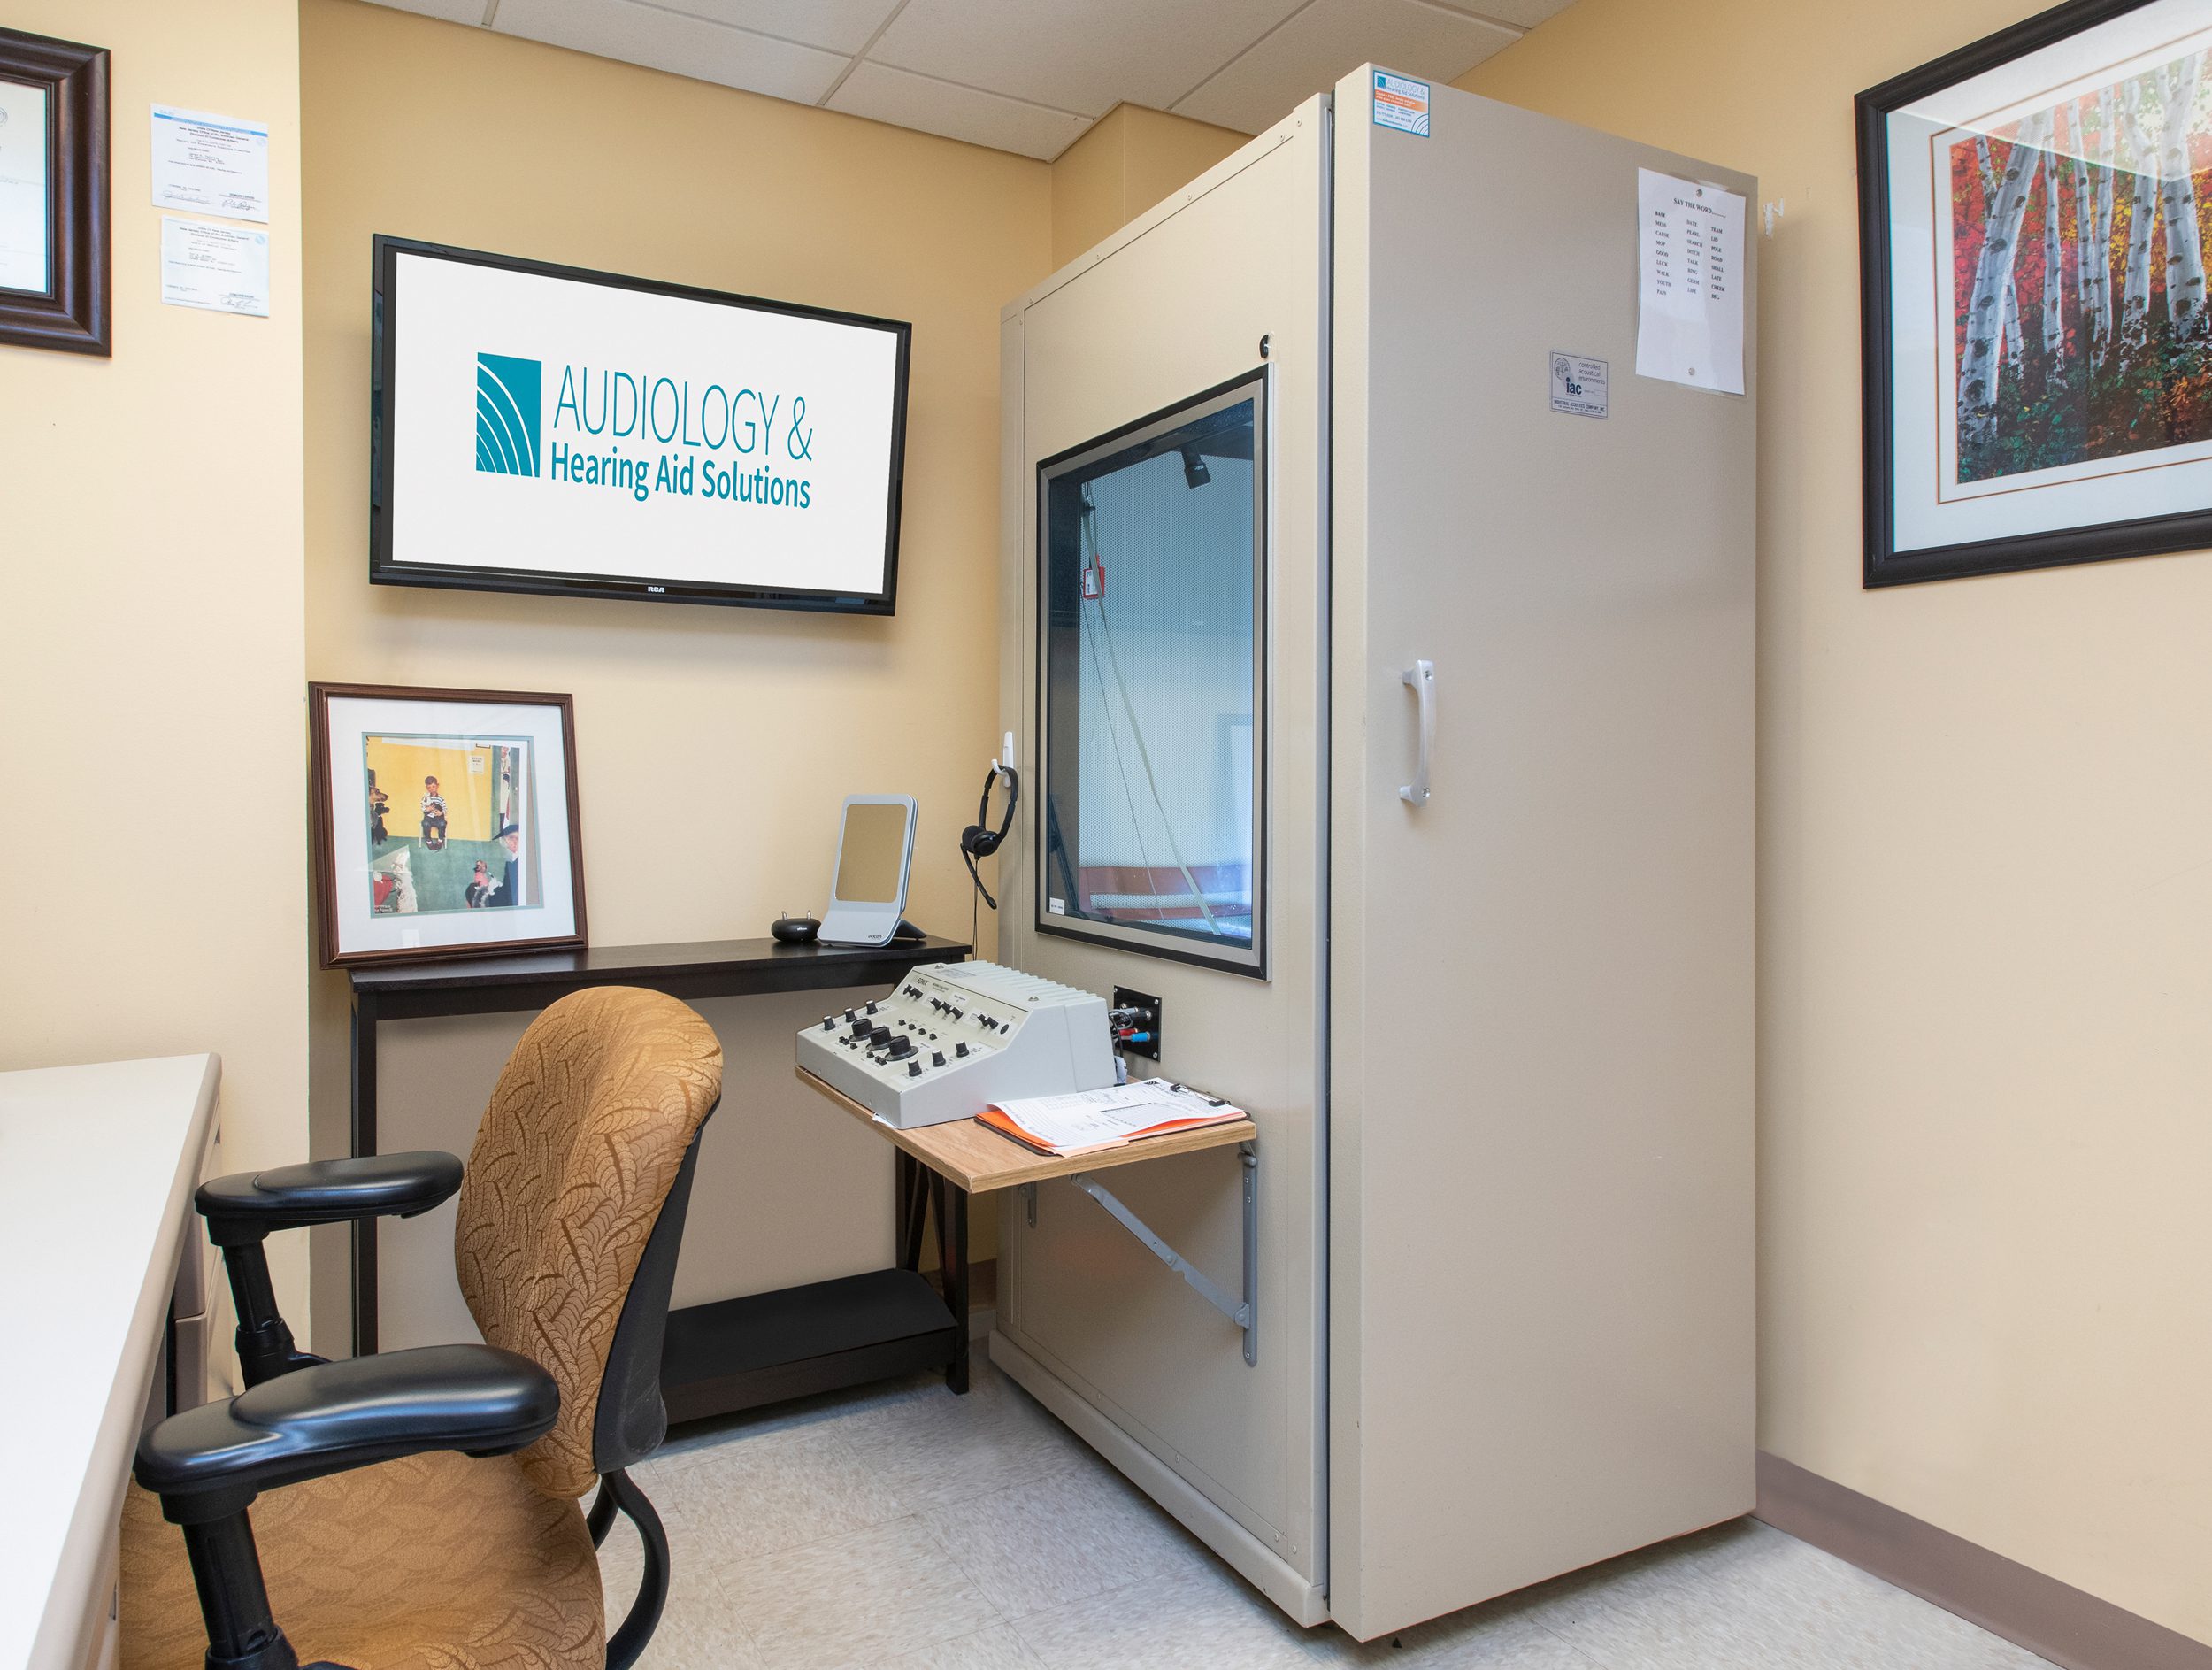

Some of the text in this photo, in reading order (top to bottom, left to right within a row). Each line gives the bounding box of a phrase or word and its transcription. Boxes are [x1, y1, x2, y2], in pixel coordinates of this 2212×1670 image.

[1673, 197, 1684, 206] SAY
[1685, 201, 1696, 210] THE
[1579, 362, 1601, 370] controlled
[1579, 369, 1601, 377] acoustical
[1566, 377, 1582, 395] iac
[554, 364, 813, 461] AUDIOLOGY &
[551, 441, 810, 510] Hearing Aid Solutions
